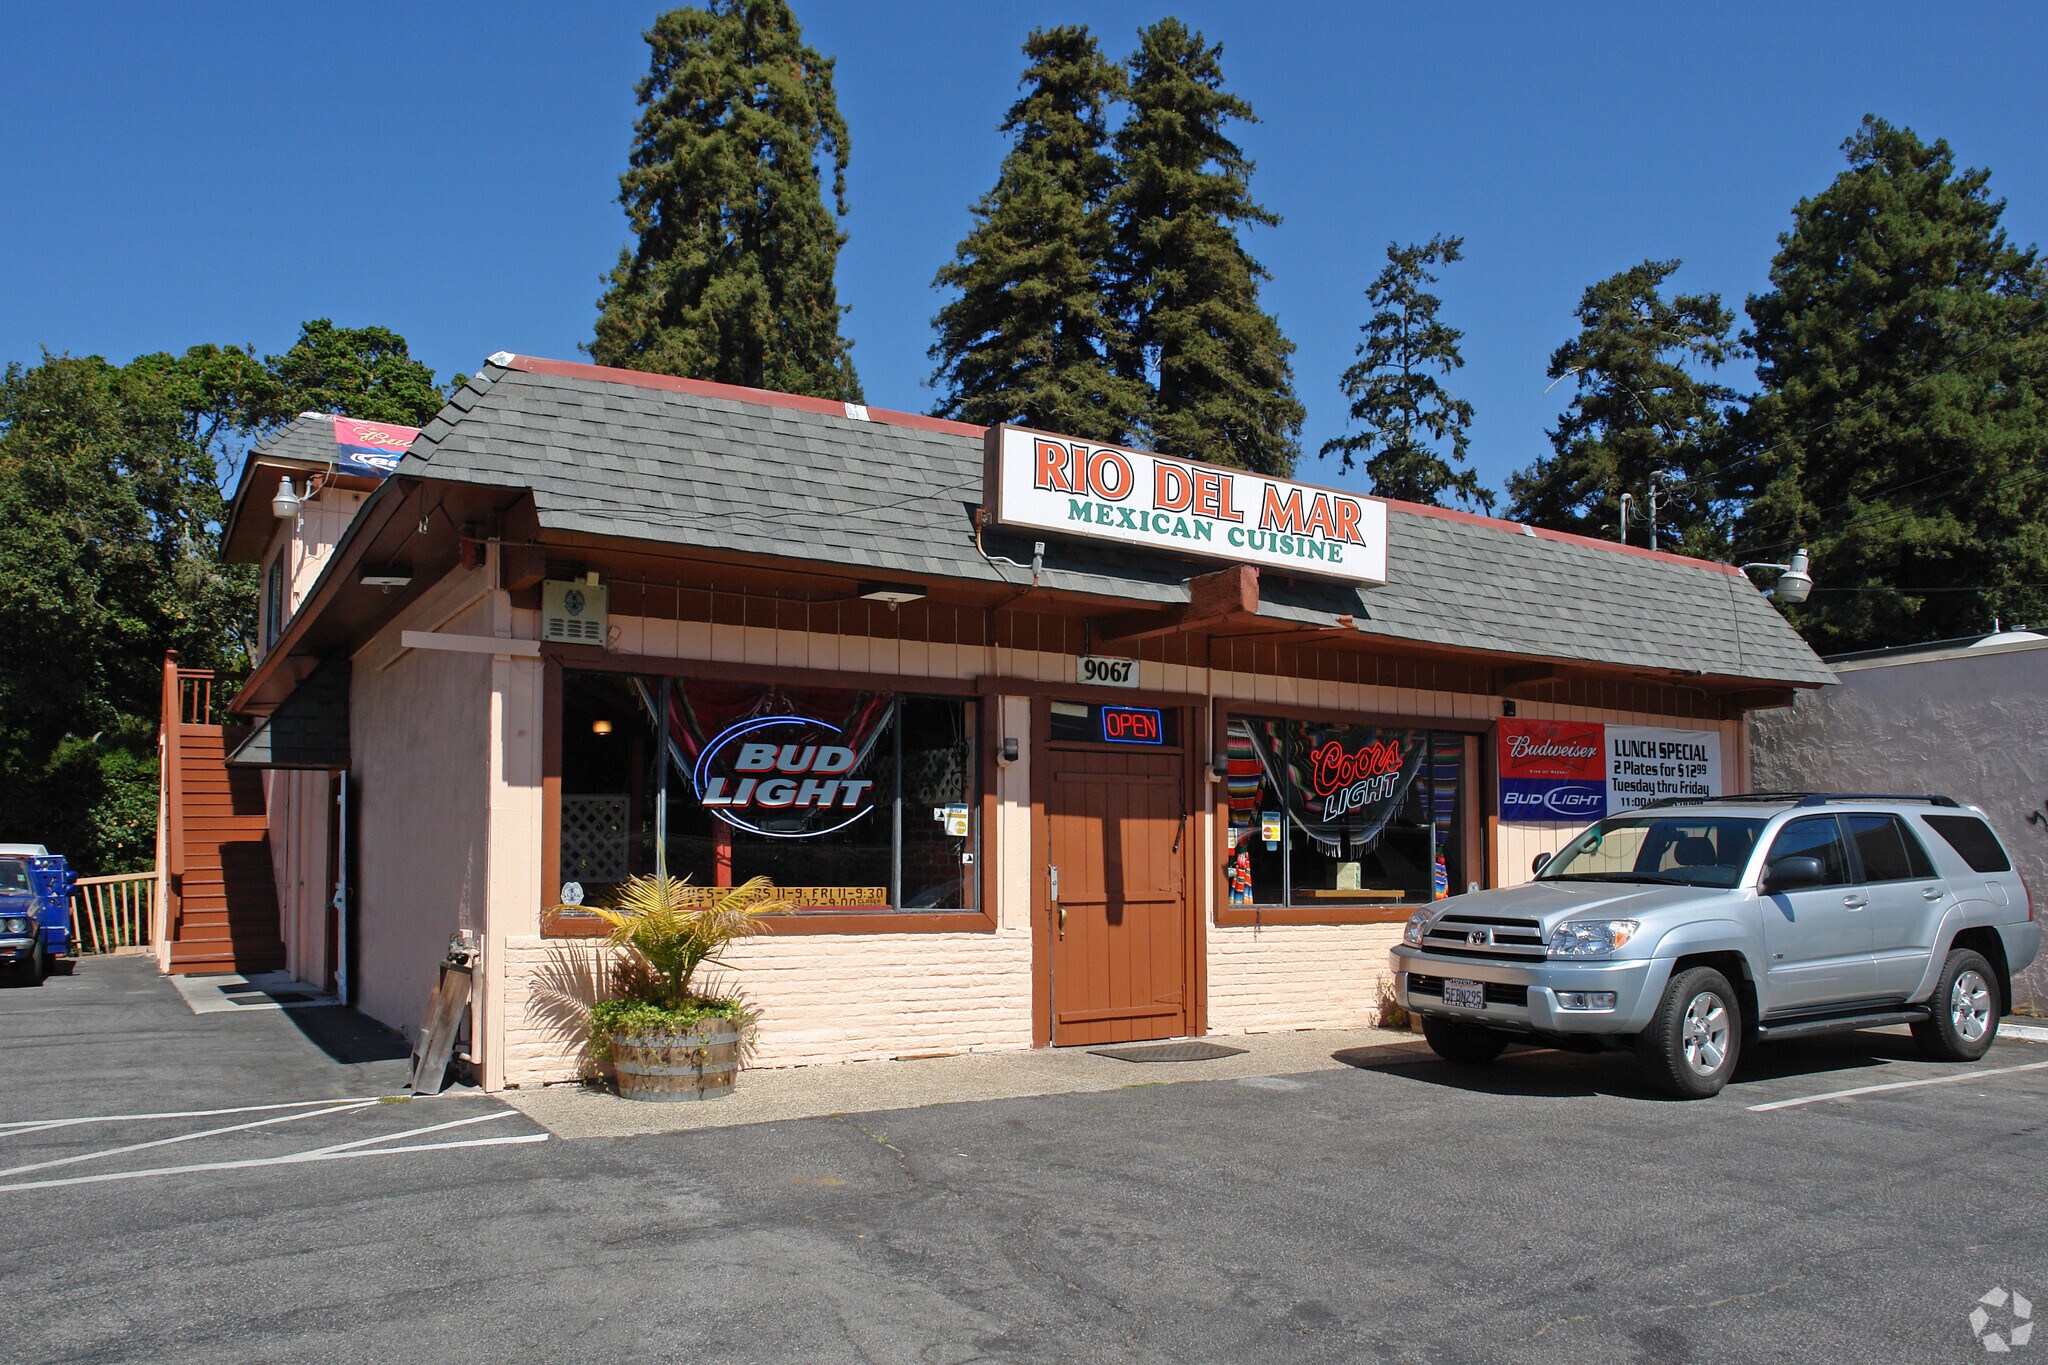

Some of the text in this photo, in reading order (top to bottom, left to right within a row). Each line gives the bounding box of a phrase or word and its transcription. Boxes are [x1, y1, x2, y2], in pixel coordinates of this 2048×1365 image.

[1034, 437, 1367, 547] RIO DEL MAR
[1068, 498, 1343, 564] MEXICAN CUISINE
[1084, 659, 1132, 683] 9067
[1107, 713, 1157, 738] OPEN
[1506, 735, 1597, 758] Budweiser
[1614, 738, 1709, 762] LUNCH SPECIAL
[734, 743, 857, 775] BUD
[1310, 740, 1403, 797] Coors
[1613, 760, 1622, 775] 2
[1623, 760, 1658, 776] Plates
[1660, 762, 1676, 777] for
[702, 777, 873, 809] LIGHT
[1323, 771, 1400, 823] LIGHT
[1504, 792, 1602, 806] BUD LIGHT
[1612, 778, 1710, 798] Tuesday thru Friday
[812, 888, 833, 899] FRI
[838, 888, 883, 899] 11-9:30
